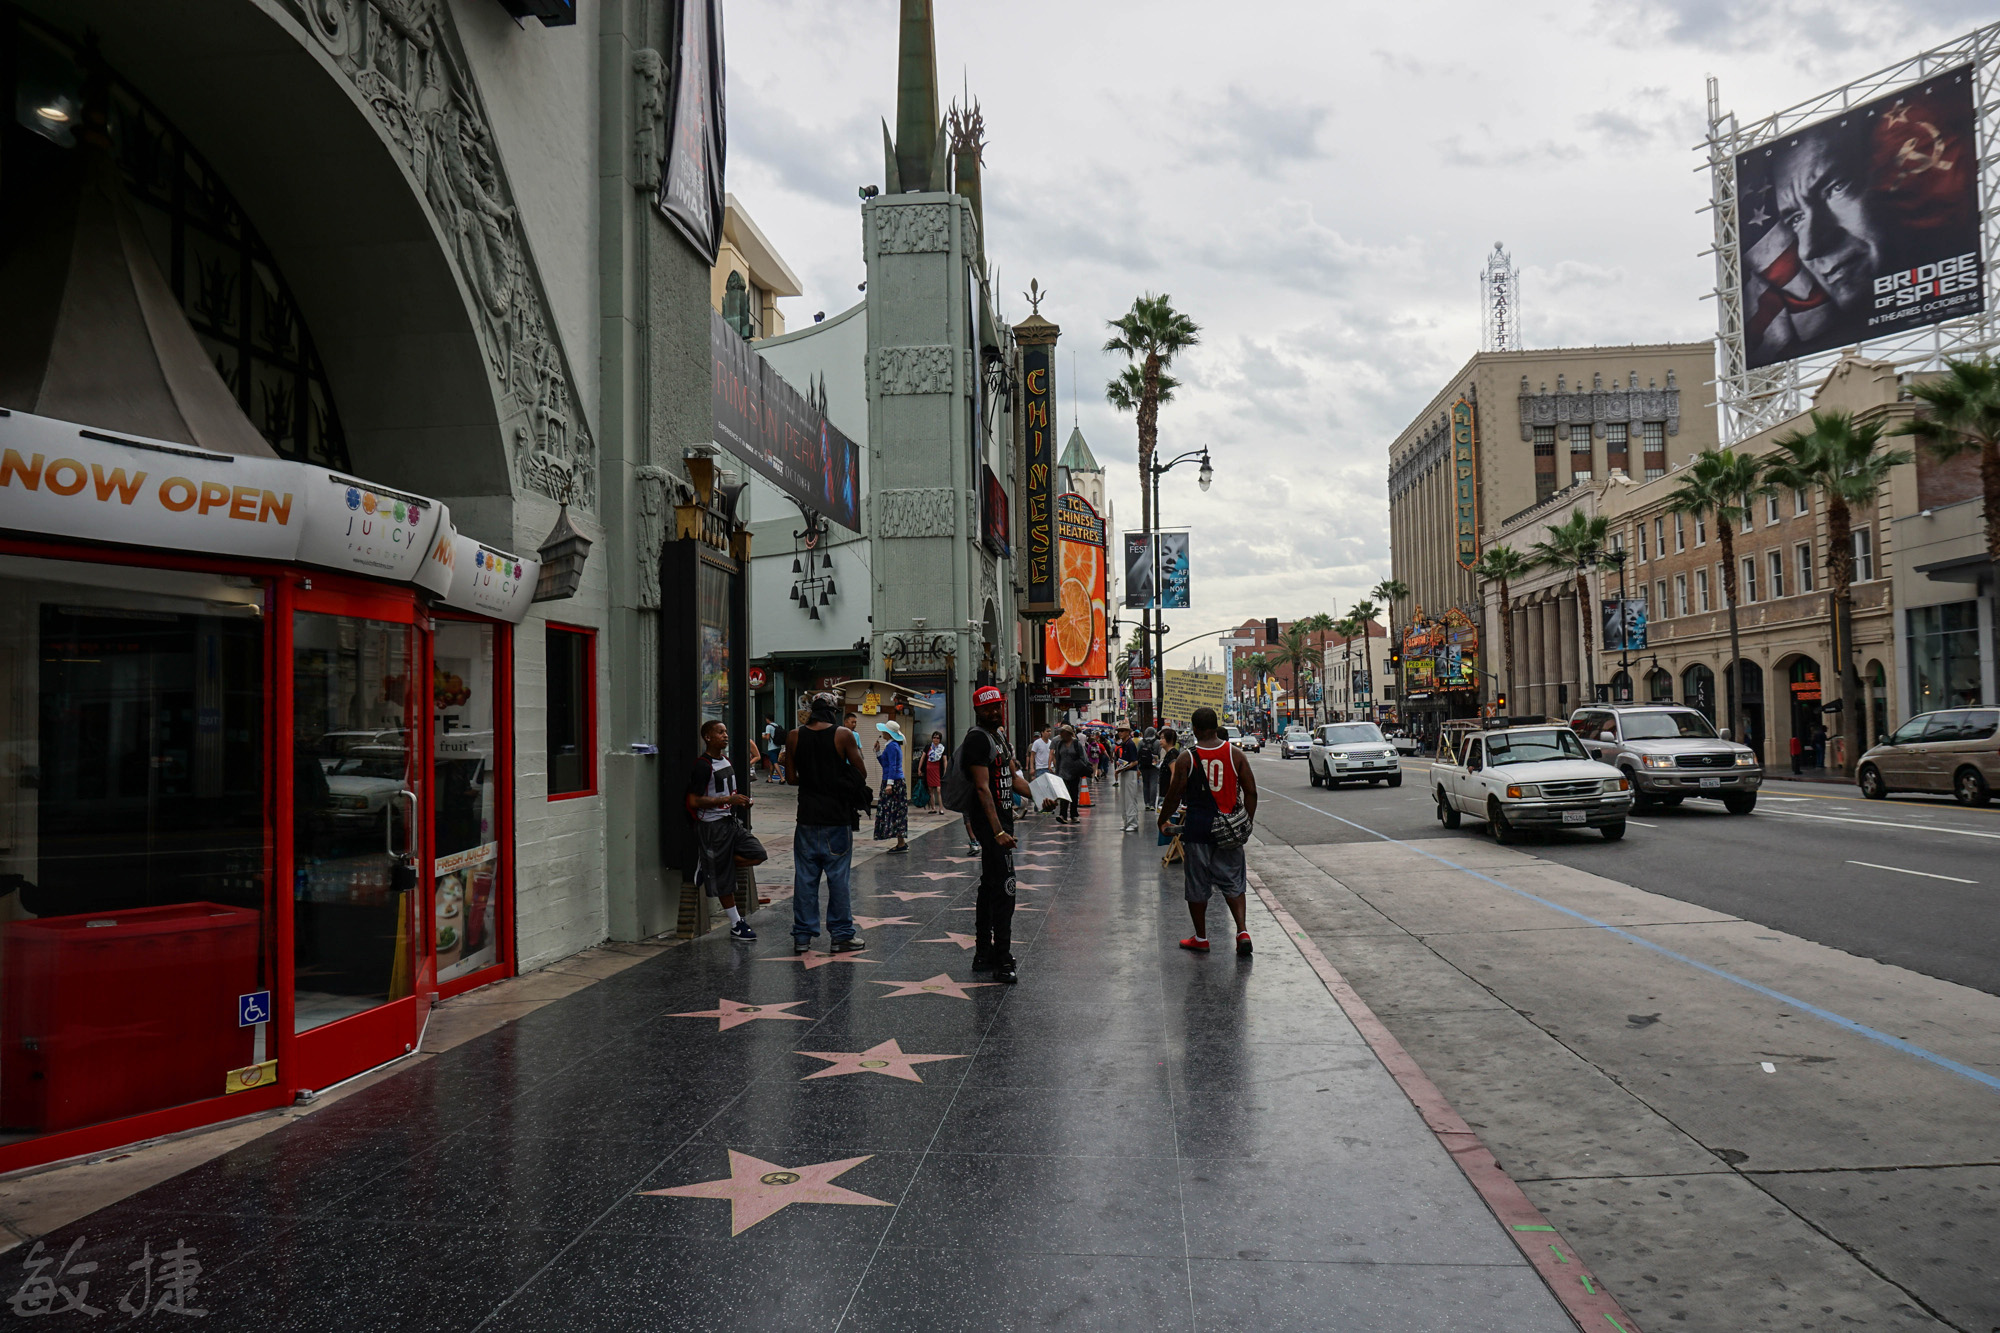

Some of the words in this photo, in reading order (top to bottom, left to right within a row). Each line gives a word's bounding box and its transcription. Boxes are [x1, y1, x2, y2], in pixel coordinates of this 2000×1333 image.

[676, 178, 708, 226] IMAX
[1873, 252, 1977, 295] BRIDGE
[1874, 295, 1896, 309] OF
[1895, 270, 1978, 307] SPIES
[1868, 315, 1879, 326] IN
[1880, 305, 1921, 323] THEATRES
[1922, 294, 1966, 312] OCTOBER
[1968, 291, 1979, 301] 16
[712, 354, 778, 443] RIMSON
[784, 421, 816, 473] PEAK
[1455, 411, 1470, 426] EL
[0, 448, 148, 505] NOW
[158, 476, 294, 525] OPEN
[785, 465, 810, 492] OCTOBER
[1027, 368, 1050, 584] CHINESE
[1456, 429, 1475, 553] CAPITAN
[1067, 498, 1084, 512] TCL
[1059, 510, 1095, 528] CHINESE
[1059, 524, 1099, 542] HEATRES
[348, 543, 405, 561] FACTORY
[1130, 545, 1148, 553] FEST
[823, 677, 842, 688] EXIT
[1697, 681, 1705, 707] ZARA
